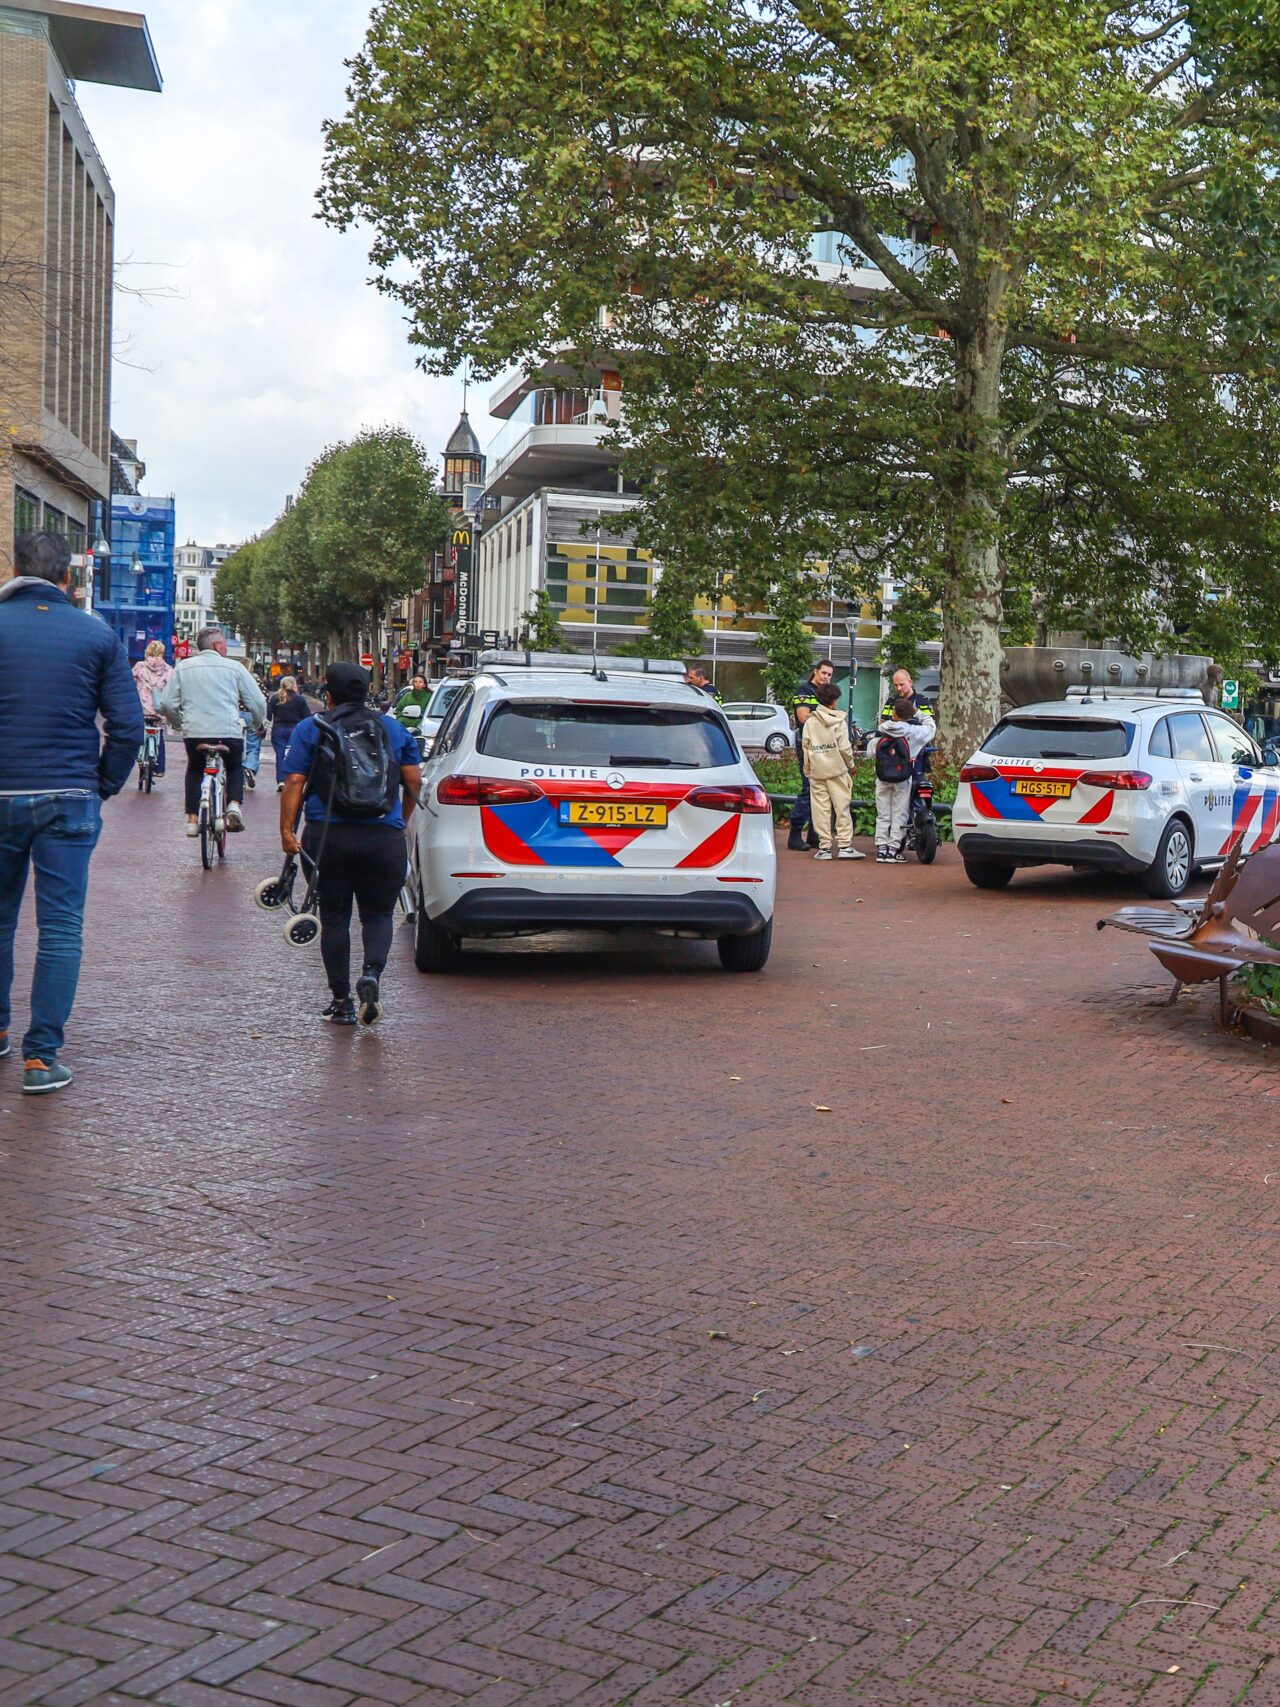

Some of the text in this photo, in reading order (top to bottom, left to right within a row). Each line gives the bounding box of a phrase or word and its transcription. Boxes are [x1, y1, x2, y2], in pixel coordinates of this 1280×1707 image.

[990, 758, 1032, 766] POLITIE
[520, 768, 598, 779] POLITIE
[1020, 782, 1067, 794] HGS-51-T
[578, 805, 655, 822] Z-915-LZ
